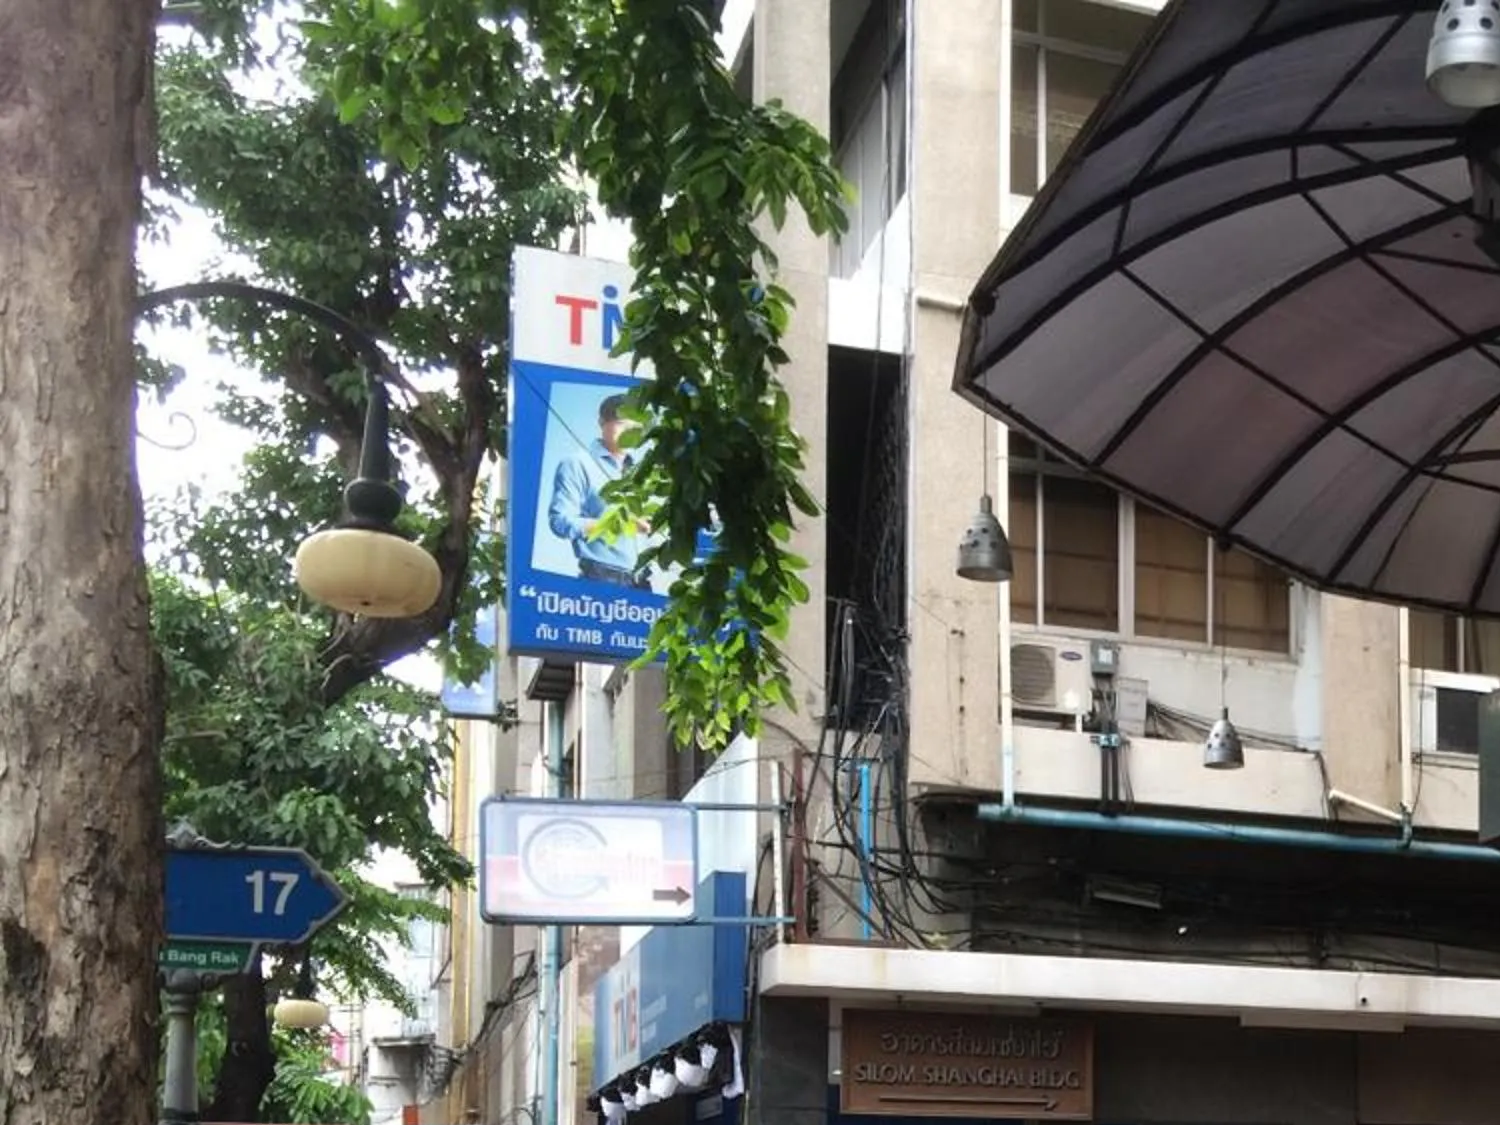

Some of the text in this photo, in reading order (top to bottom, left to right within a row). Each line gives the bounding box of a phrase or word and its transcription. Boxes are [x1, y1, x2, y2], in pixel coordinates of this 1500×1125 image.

[565, 627, 603, 645] TMB
[245, 870, 300, 916] 17
[167, 948, 207, 966] Bang
[211, 950, 239, 965] Rak
[855, 1061, 915, 1085] SILOM
[922, 1065, 1024, 1088] SHANGHAI
